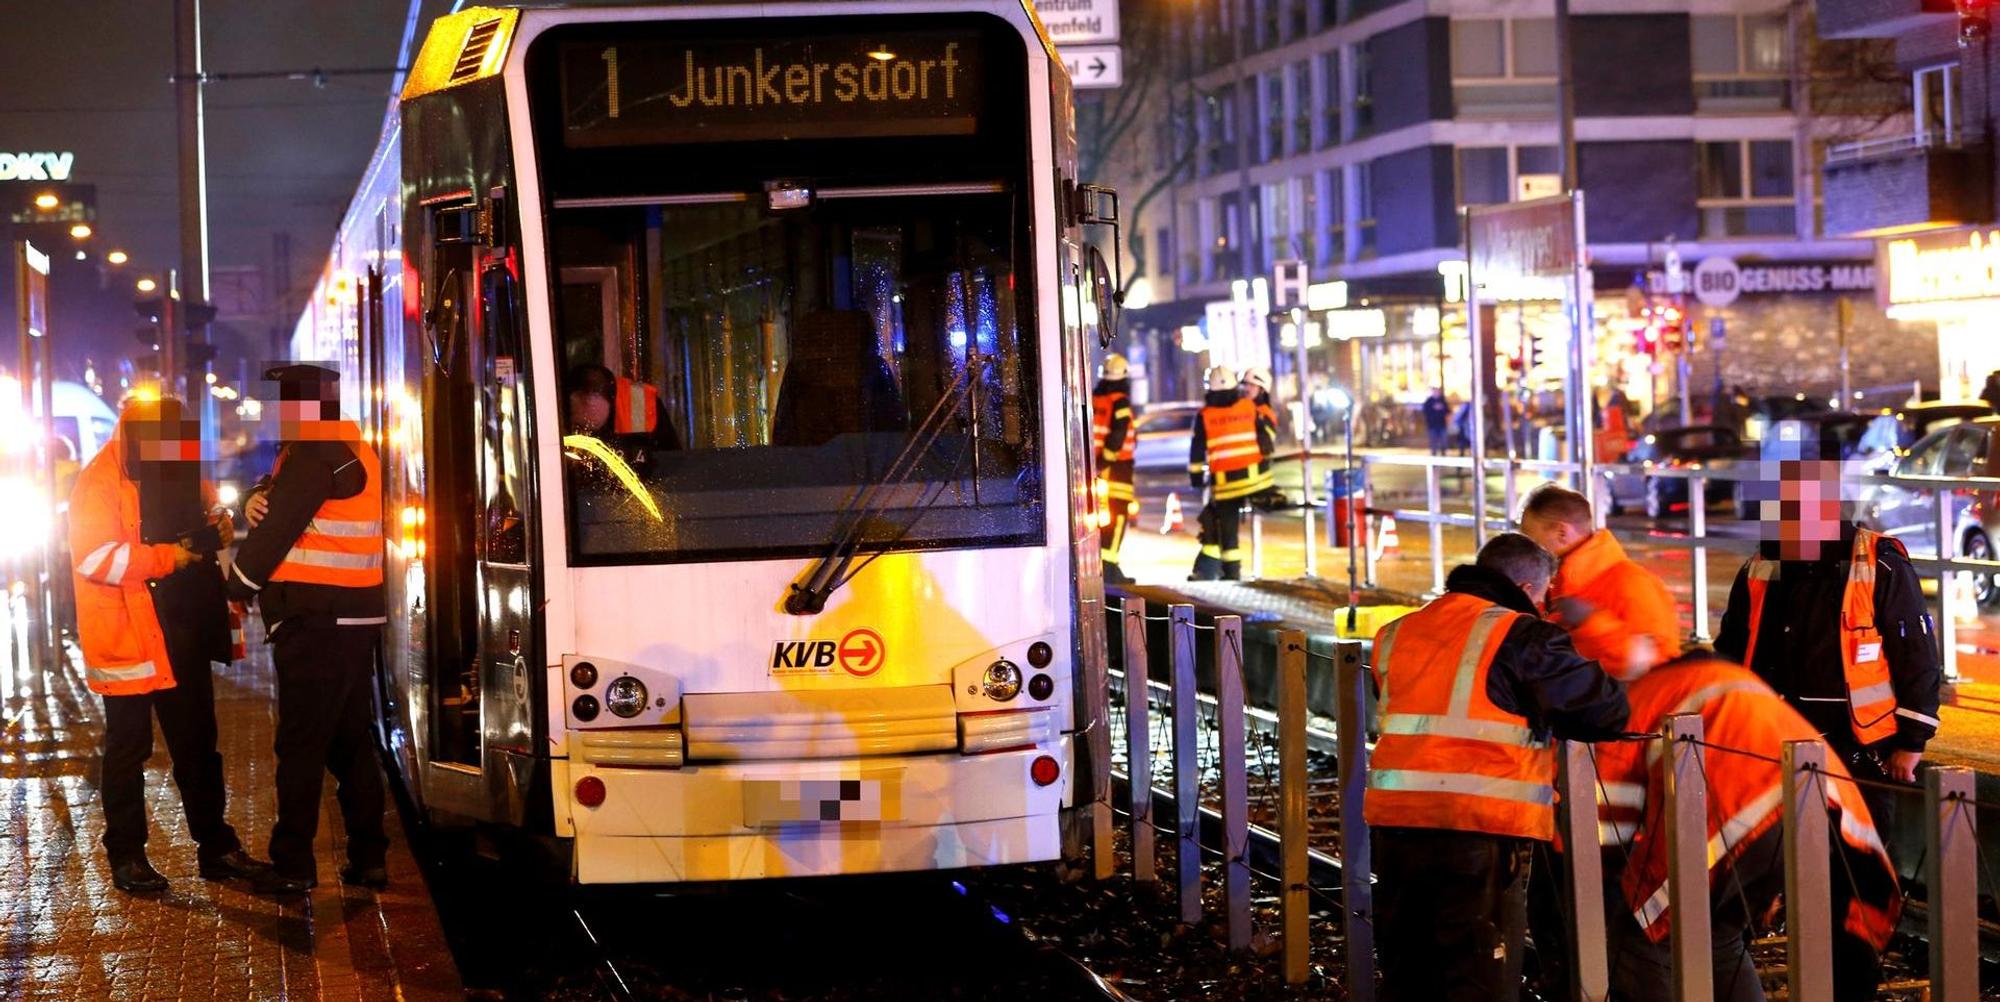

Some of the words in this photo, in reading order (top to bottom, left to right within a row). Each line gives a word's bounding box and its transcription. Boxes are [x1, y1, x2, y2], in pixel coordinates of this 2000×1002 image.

[1035, 0, 1092, 12] entrum
[1047, 17, 1101, 33] renfeld
[601, 47, 619, 118] 1
[669, 42, 958, 107] Junkersdorf
[0, 152, 74, 181] DKV
[1274, 264, 1308, 306] H
[1651, 269, 1692, 293] DR
[1701, 271, 1736, 292] BIO
[1741, 266, 1875, 292] GENUSS-MAR
[773, 641, 836, 668] KVB
